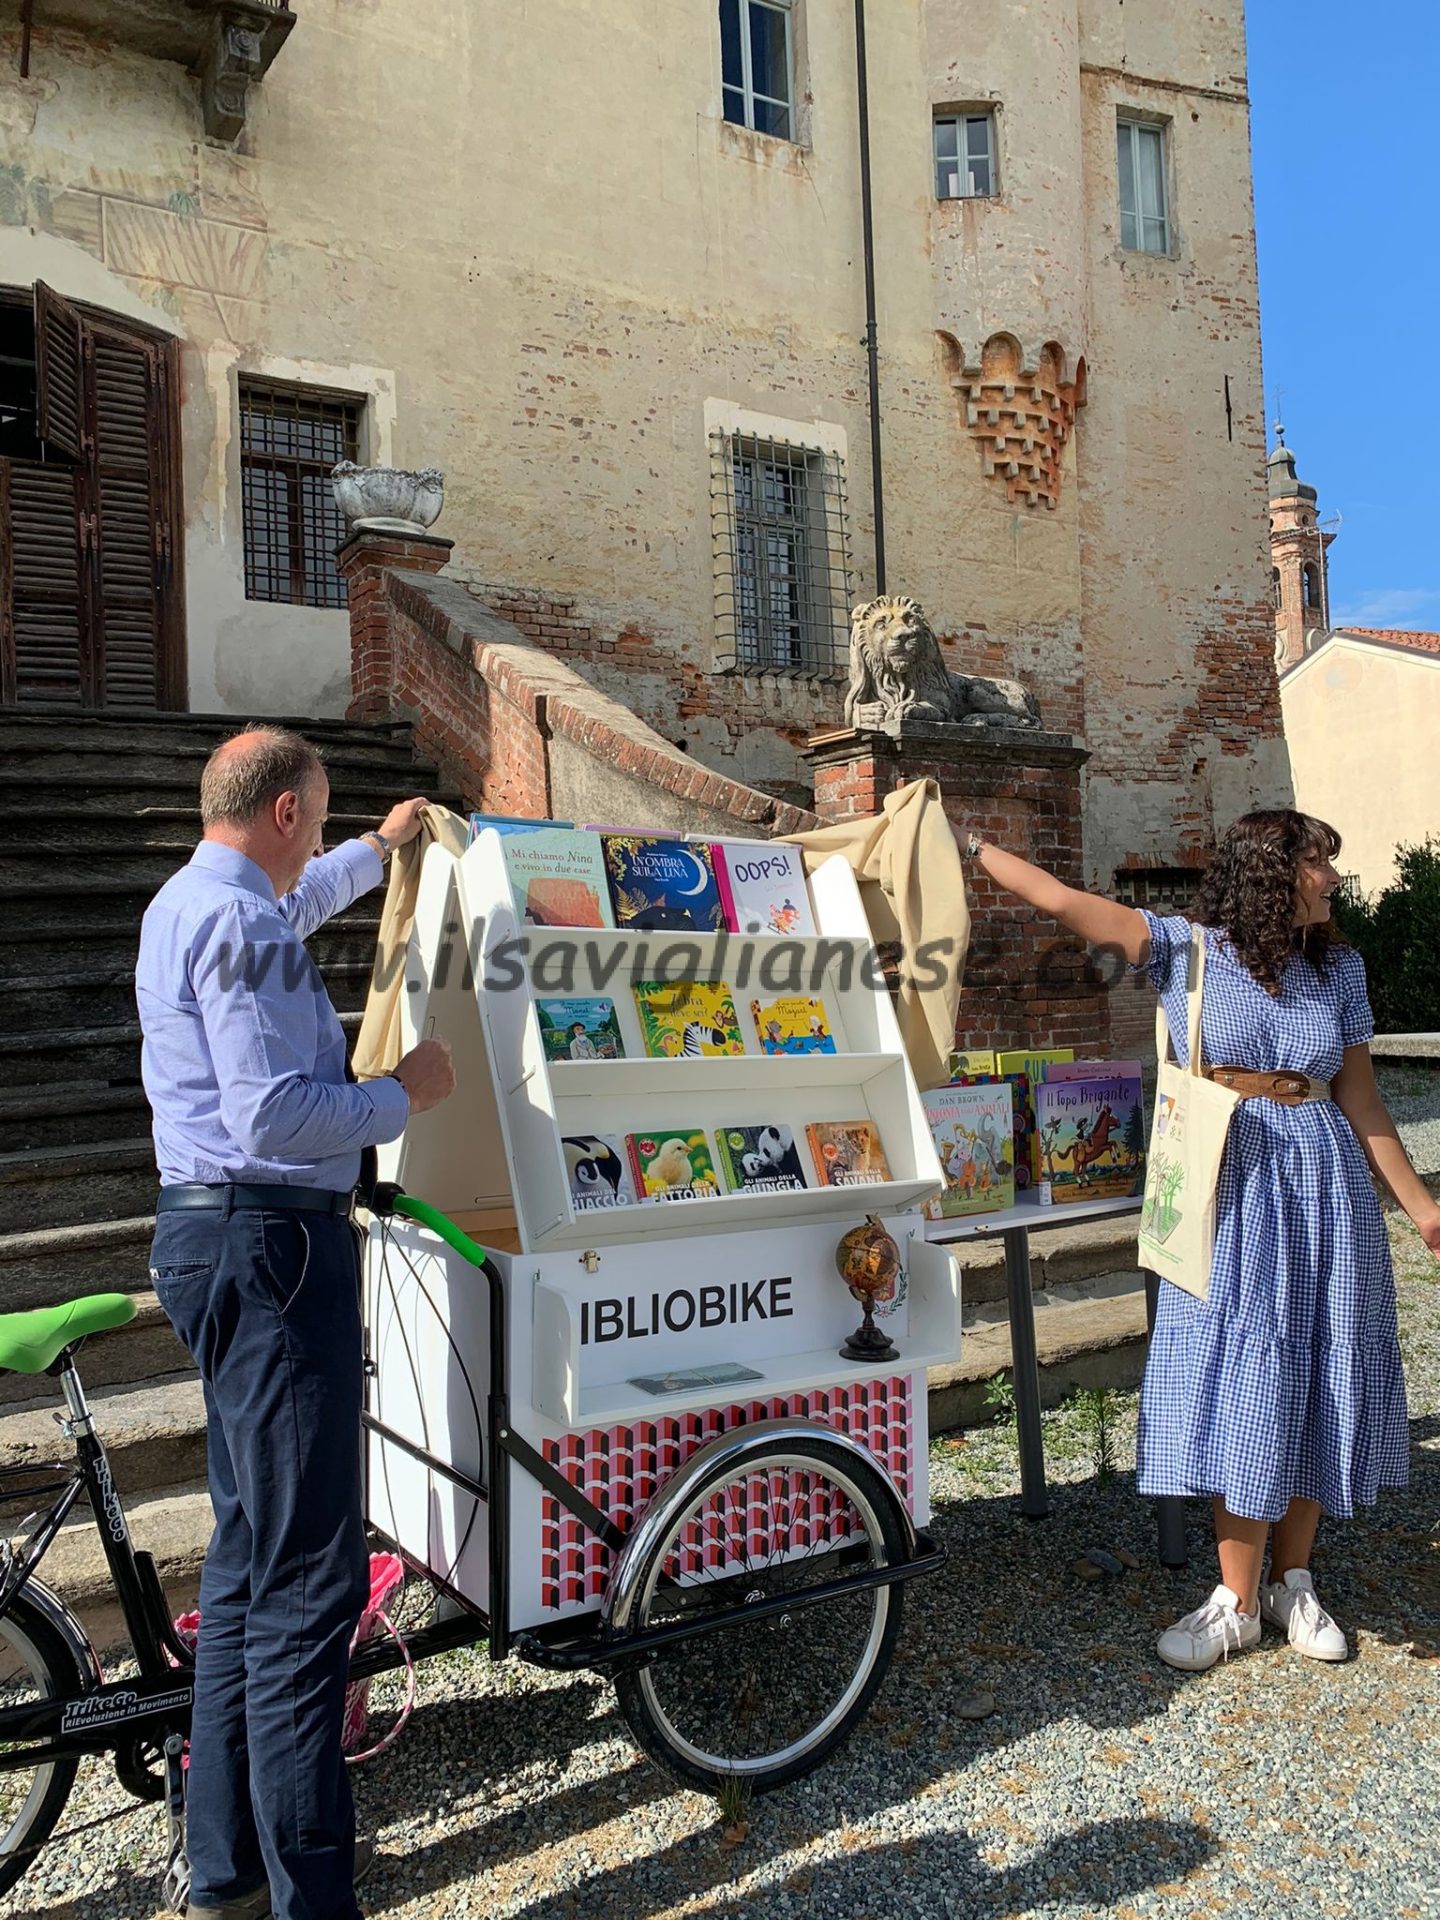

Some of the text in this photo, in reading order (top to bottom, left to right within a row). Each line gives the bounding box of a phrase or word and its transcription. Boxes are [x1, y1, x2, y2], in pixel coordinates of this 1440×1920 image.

[511, 848, 593, 863] Mi chiamo Nina
[522, 862, 540, 871] vivo
[543, 863, 552, 872] in
[554, 862, 572, 873] due
[735, 855, 792, 882] OOPS!
[939, 1095, 984, 1106] DAN BROWN
[1056, 1089, 1077, 1112] Topo
[1080, 1084, 1130, 1112] Brigante
[743, 1178, 804, 1194] GIUNGLA
[835, 1174, 885, 1186] SAVANA
[651, 1186, 718, 1201] FATTORIA
[581, 1276, 793, 1345] IBLIOBIKE
[92, 1455, 126, 1543] TrikeGo
[65, 1691, 137, 1717] TrikeGo
[127, 1705, 136, 1715] in
[138, 1693, 189, 1712] Movimento
